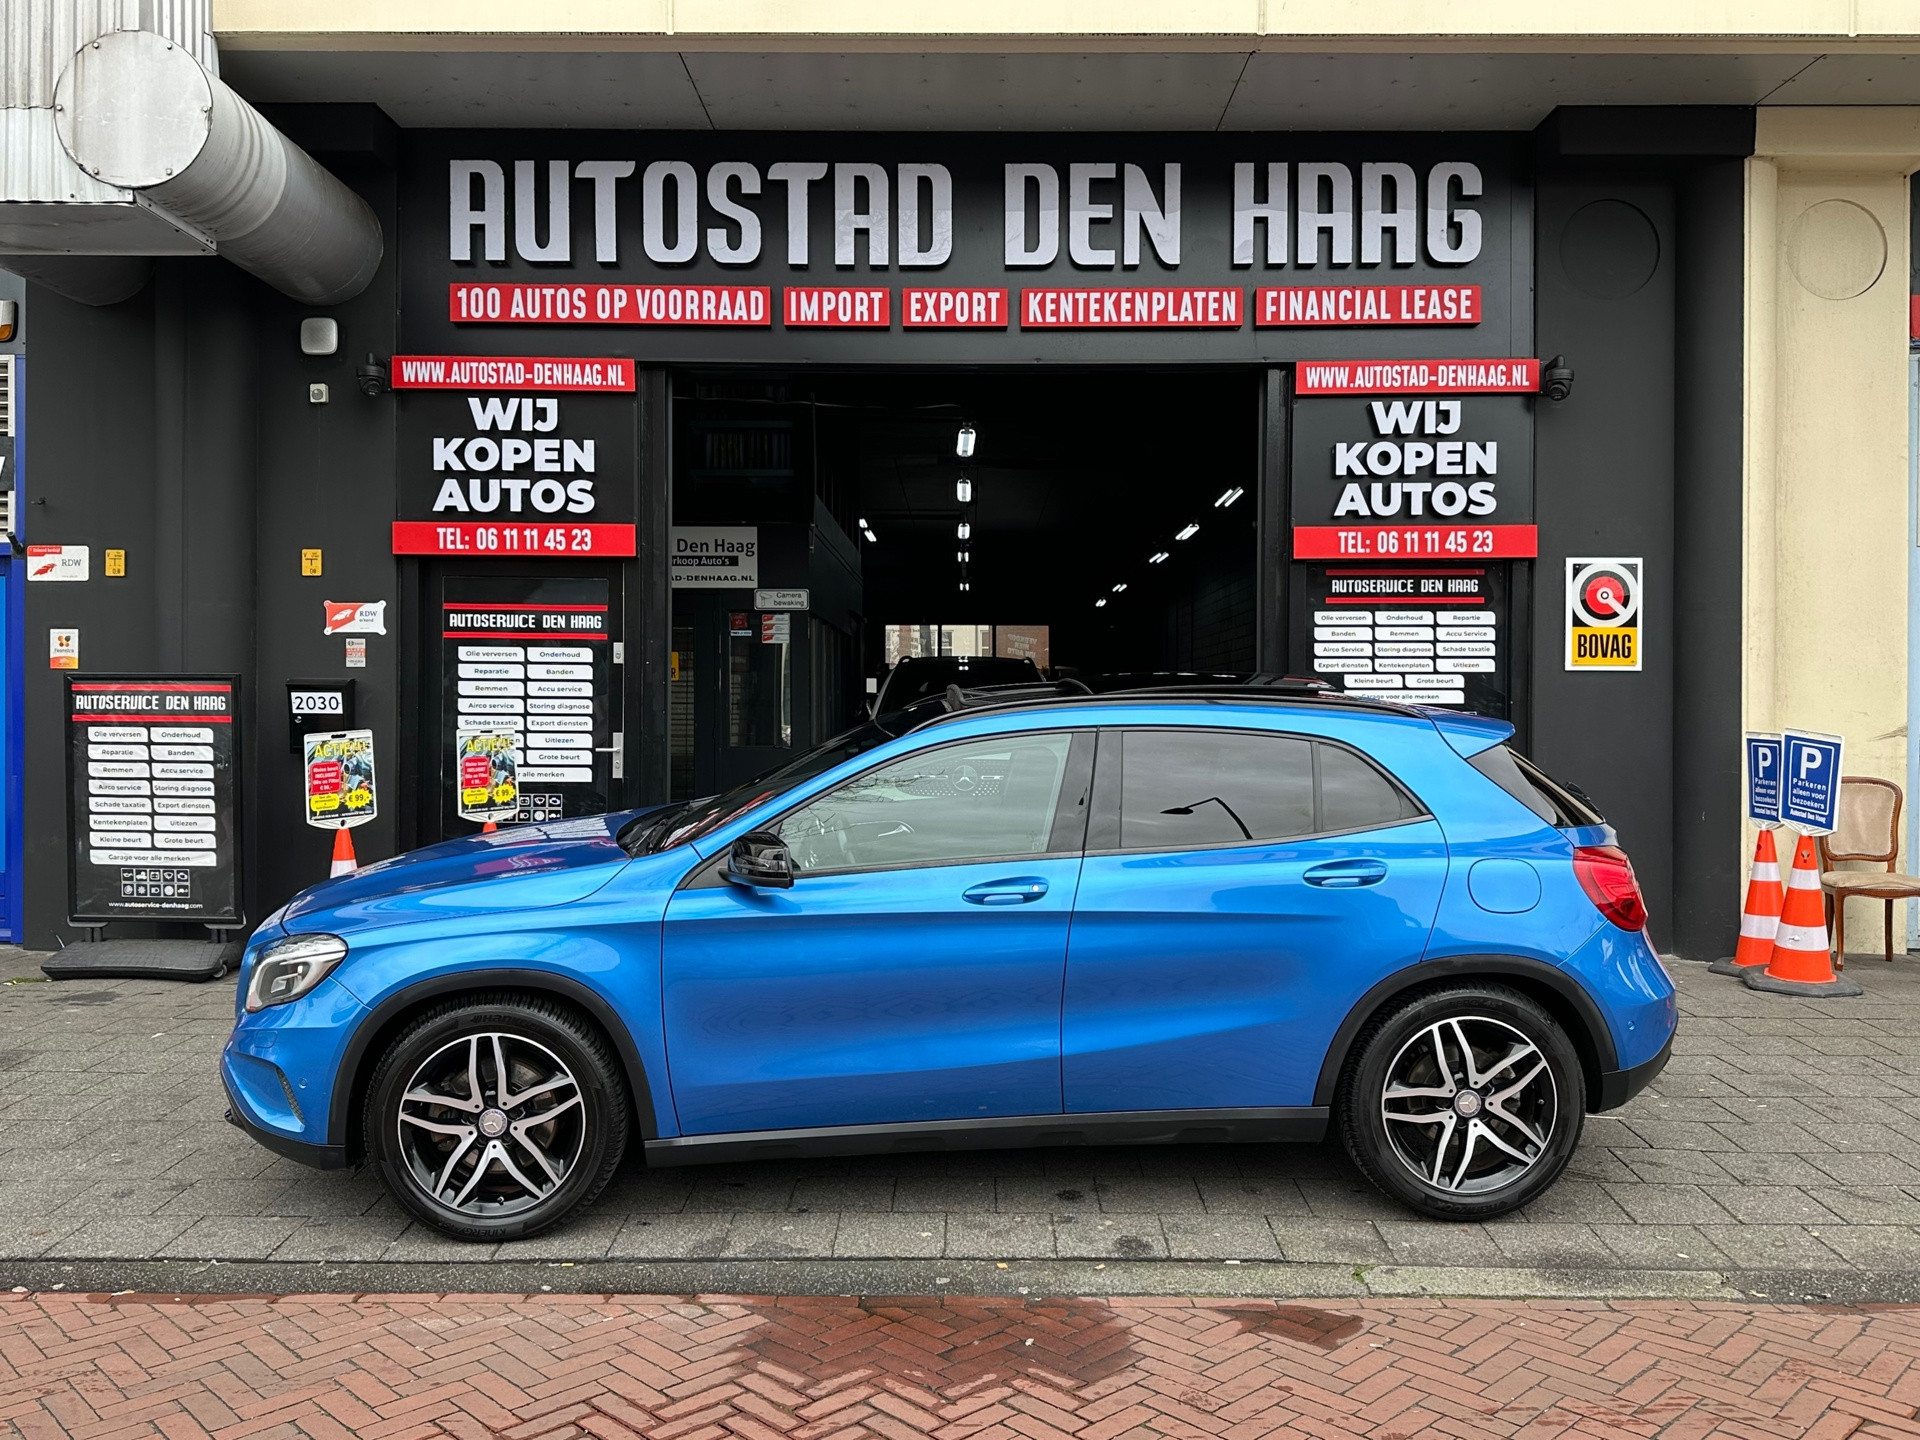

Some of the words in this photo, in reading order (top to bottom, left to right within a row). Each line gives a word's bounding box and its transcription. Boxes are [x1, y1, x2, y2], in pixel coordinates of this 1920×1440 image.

[450, 160, 952, 266] AUTOSTAD
[1004, 163, 1181, 265] DEN
[1233, 162, 1482, 264] HAAG
[457, 288, 500, 319] 100
[511, 288, 587, 320] AUTOS
[596, 289, 627, 320] OP
[638, 290, 764, 321] VOORRAAD
[790, 291, 883, 322] IMPORT
[910, 291, 1000, 323] EXPORT
[1028, 292, 1236, 323] KENTEKENPLATEN
[1265, 289, 1391, 321] FINANCIAL
[1401, 288, 1472, 320] LEASE
[402, 362, 625, 386] WWW.AUTOSTAD-DENHAAG.NL
[1306, 364, 1530, 390] WWW.AUTOSTAD-DENHAAG.NL
[468, 398, 559, 432] WIJ
[1371, 401, 1462, 435] WIJ
[433, 439, 594, 472] KOPEN
[1336, 442, 1497, 476] KOPEN
[432, 479, 595, 514] AUTOS
[1334, 482, 1497, 517] AUTOS
[437, 528, 469, 550] TEL:
[476, 529, 498, 550] 06
[503, 529, 519, 550] 11
[523, 529, 539, 550] 11
[544, 530, 566, 551] 45
[570, 530, 592, 551] 23
[677, 538, 709, 552] Den
[715, 538, 755, 556] Haag
[1338, 532, 1371, 554] TEL:
[1377, 530, 1399, 554] 06
[1405, 531, 1419, 553] 11
[1424, 531, 1439, 553] 11
[1446, 531, 1468, 553] 45
[1472, 531, 1494, 553] 23
[672, 557, 698, 566] rkoop
[701, 557, 729, 565] Auto's
[1332, 579, 1413, 593] AUTOSERVICE
[1421, 579, 1443, 593] DEN
[1448, 579, 1478, 593] HAAG
[449, 614, 535, 628] AUTOSERVICE
[542, 615, 566, 628] DEN
[570, 615, 602, 629] HAAG
[1577, 634, 1632, 659] BOVAG
[76, 696, 159, 710] AUTOSERVICE
[166, 696, 189, 710] DEN
[194, 696, 226, 710] HAAG
[294, 696, 339, 710] 2030
[1758, 747, 1771, 777] P
[1800, 747, 1822, 779] P
[1755, 778, 1776, 786] Parkeren
[1793, 778, 1826, 791] Parkeren
[1793, 788, 1810, 797] alleen
[1811, 791, 1826, 800] voor
[1792, 797, 1824, 809] bezoekers
[108, 901, 203, 910] www.autoservice-denhaag.com
